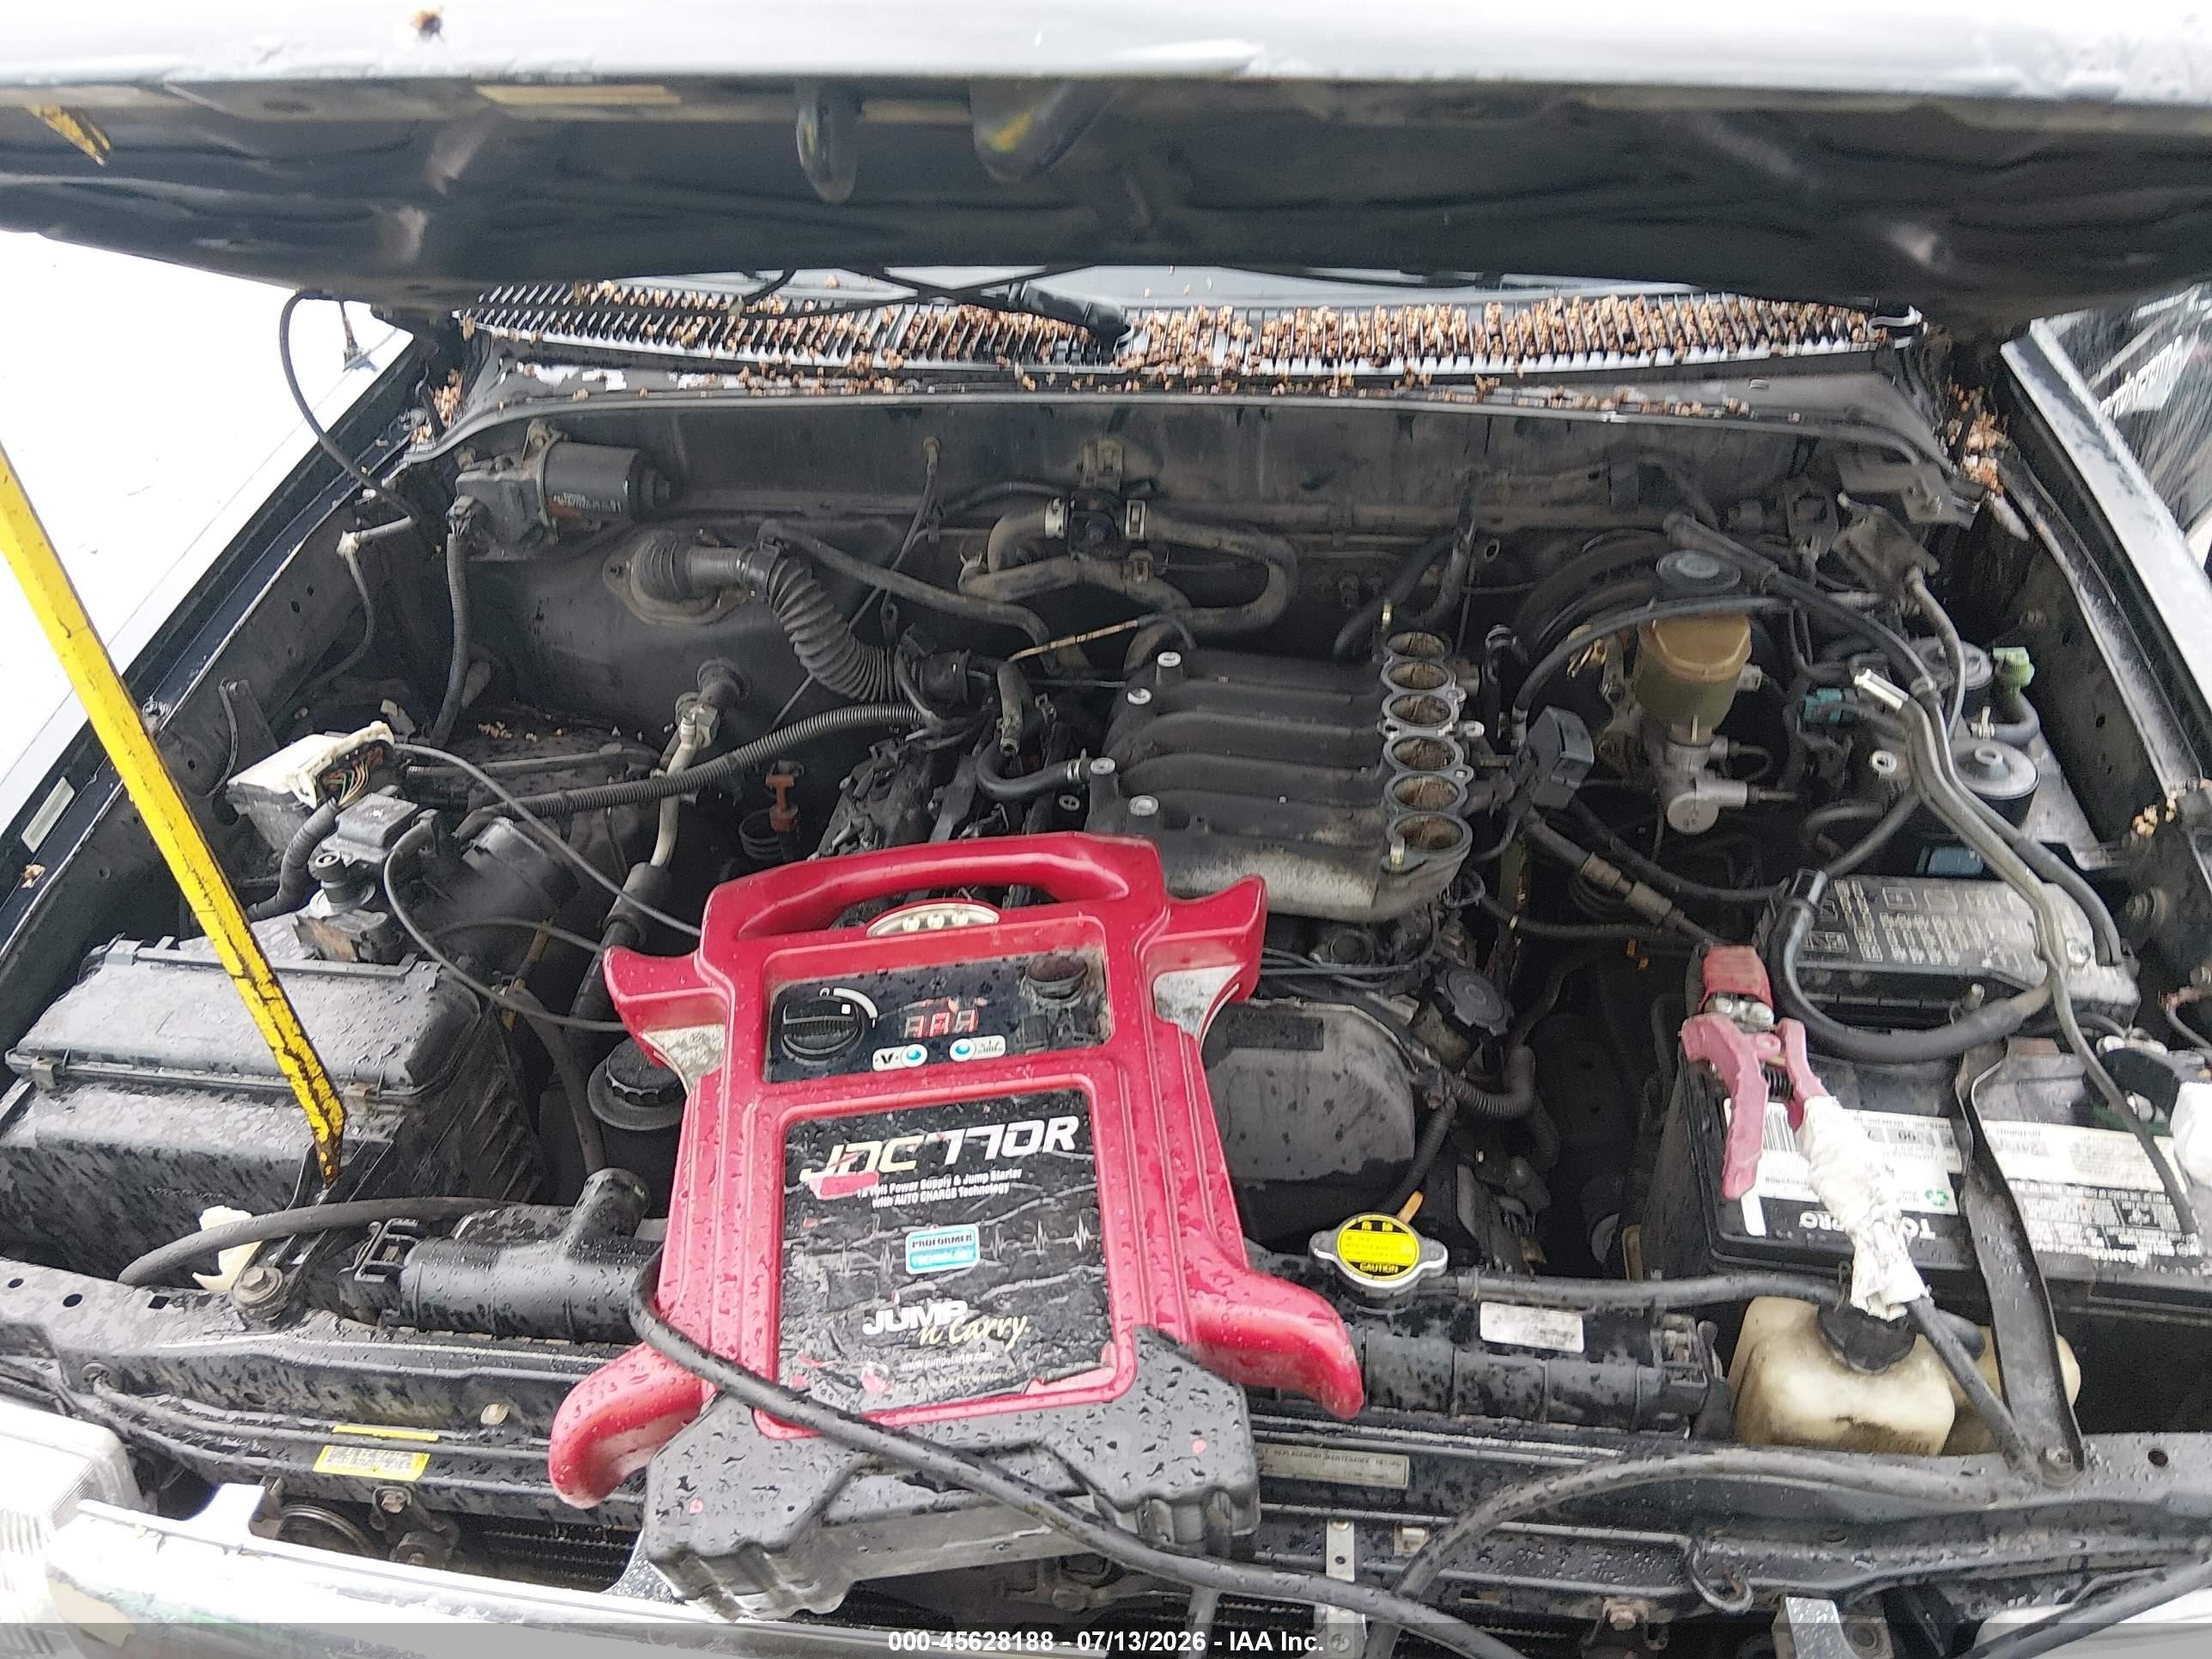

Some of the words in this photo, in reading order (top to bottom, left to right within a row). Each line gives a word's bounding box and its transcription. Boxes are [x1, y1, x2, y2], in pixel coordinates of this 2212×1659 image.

[890, 1182, 919, 1194] Power
[921, 1176, 951, 1190] Supply
[954, 1176, 961, 1186] &
[963, 1173, 988, 1185] Jump
[990, 1168, 1023, 1181] Starter
[895, 1194, 919, 1206] AUTO
[1359, 1262, 1400, 1273] CAUTION
[862, 1300, 969, 1335] JUMP
